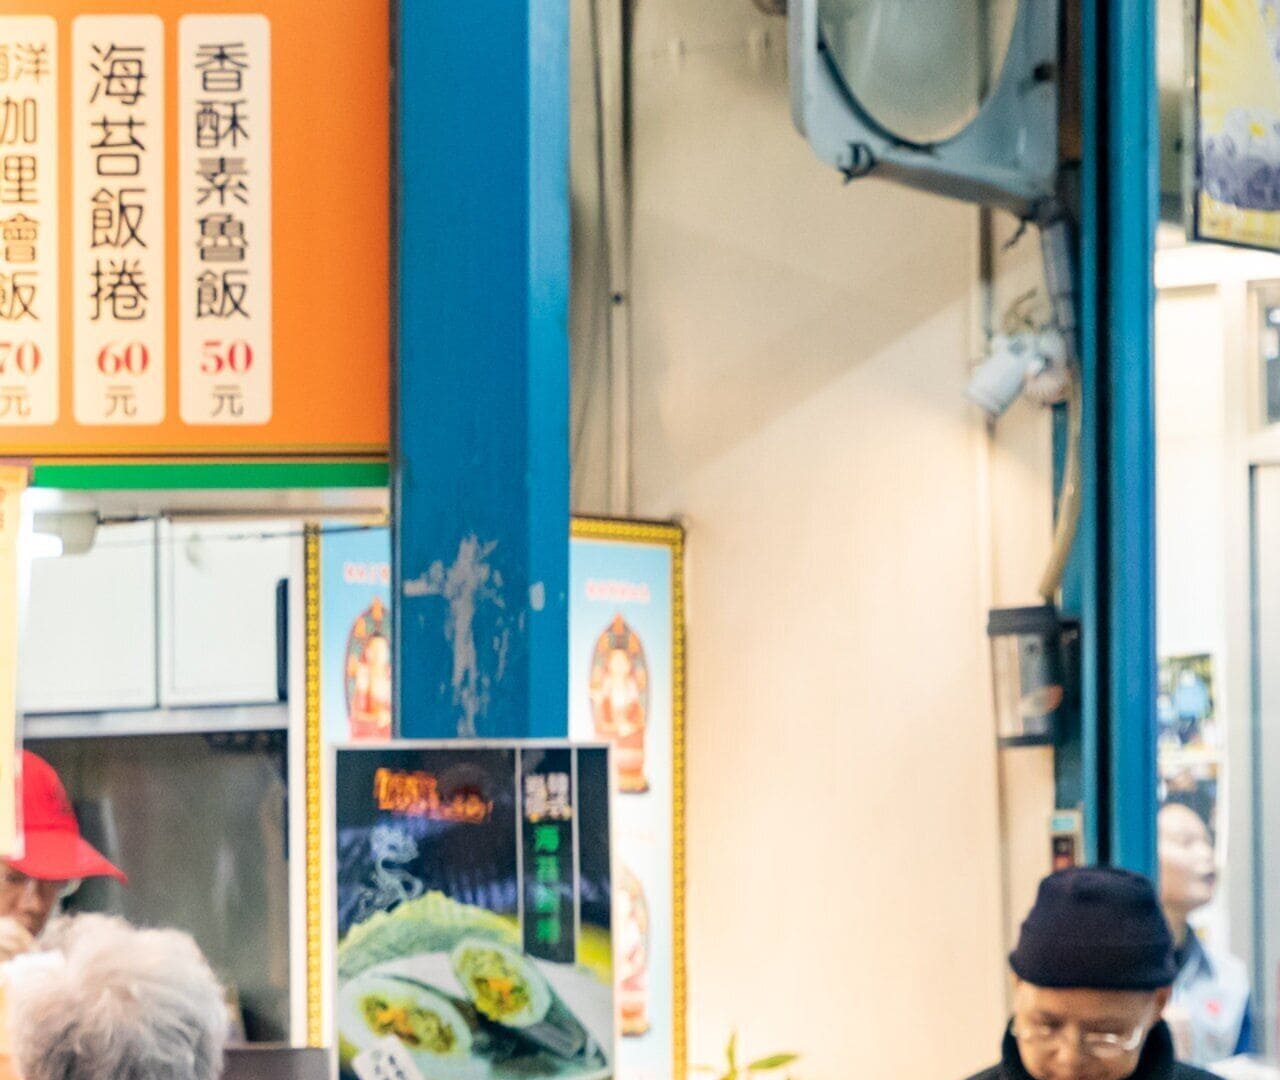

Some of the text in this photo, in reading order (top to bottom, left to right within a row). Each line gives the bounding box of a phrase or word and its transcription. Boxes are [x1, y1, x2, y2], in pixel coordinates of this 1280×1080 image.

[90, 43, 148, 321] 海苔飯捲
[195, 43, 249, 320] 香酥素魯飯
[97, 341, 150, 374] 60
[200, 339, 253, 373] 50
[105, 386, 137, 417] 元
[211, 385, 244, 417] 元
